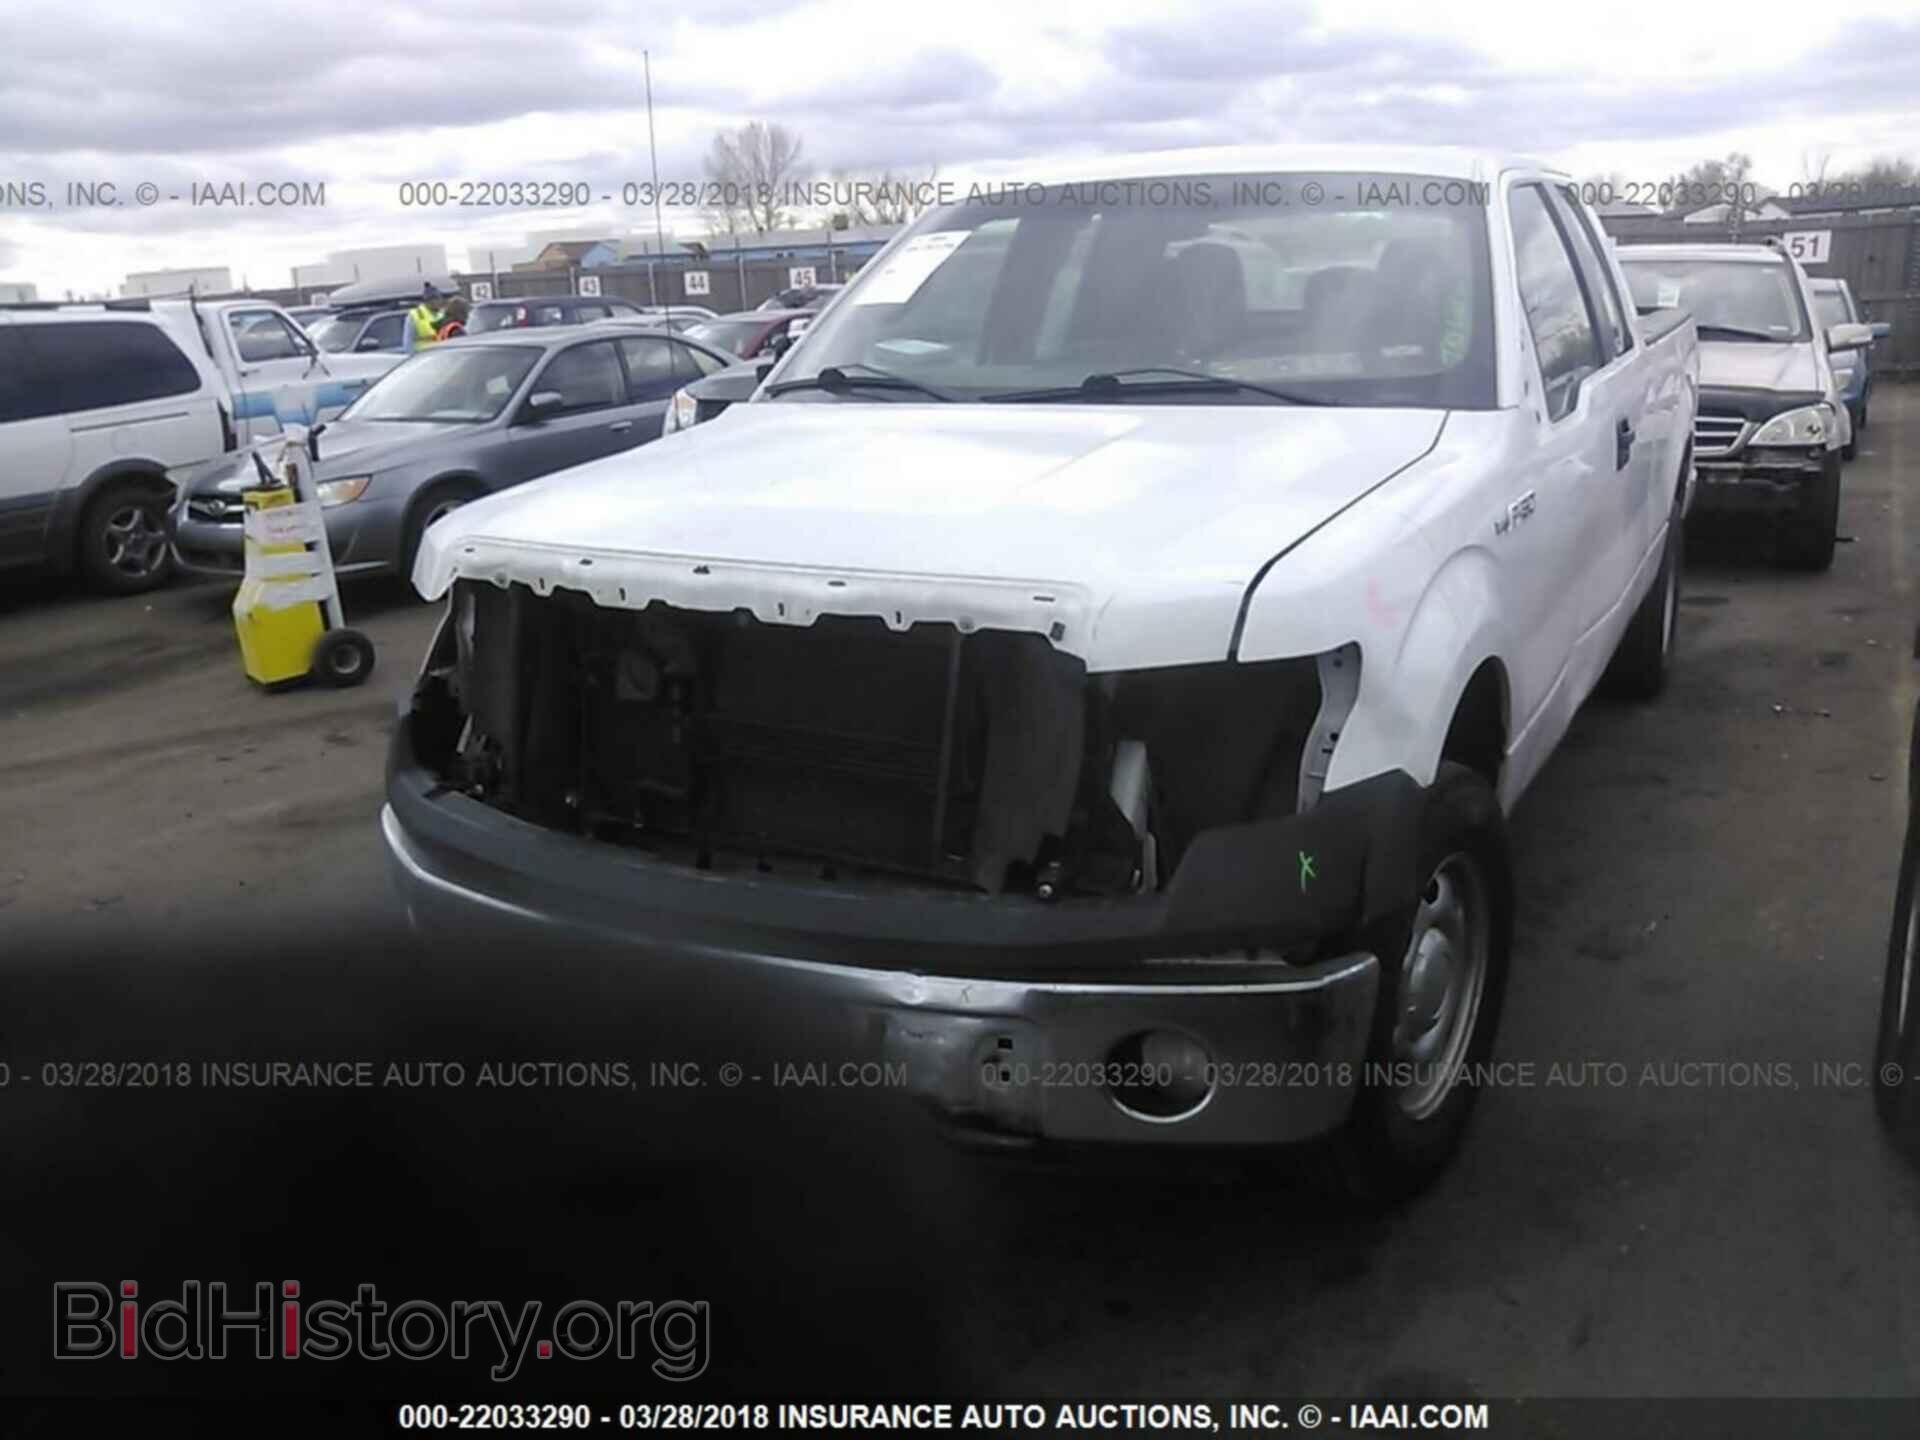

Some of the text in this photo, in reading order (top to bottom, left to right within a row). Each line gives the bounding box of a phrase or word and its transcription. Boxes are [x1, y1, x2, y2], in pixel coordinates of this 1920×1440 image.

[1791, 236, 1819, 258] 51
[689, 275, 705, 289] 44
[795, 270, 812, 286] 45
